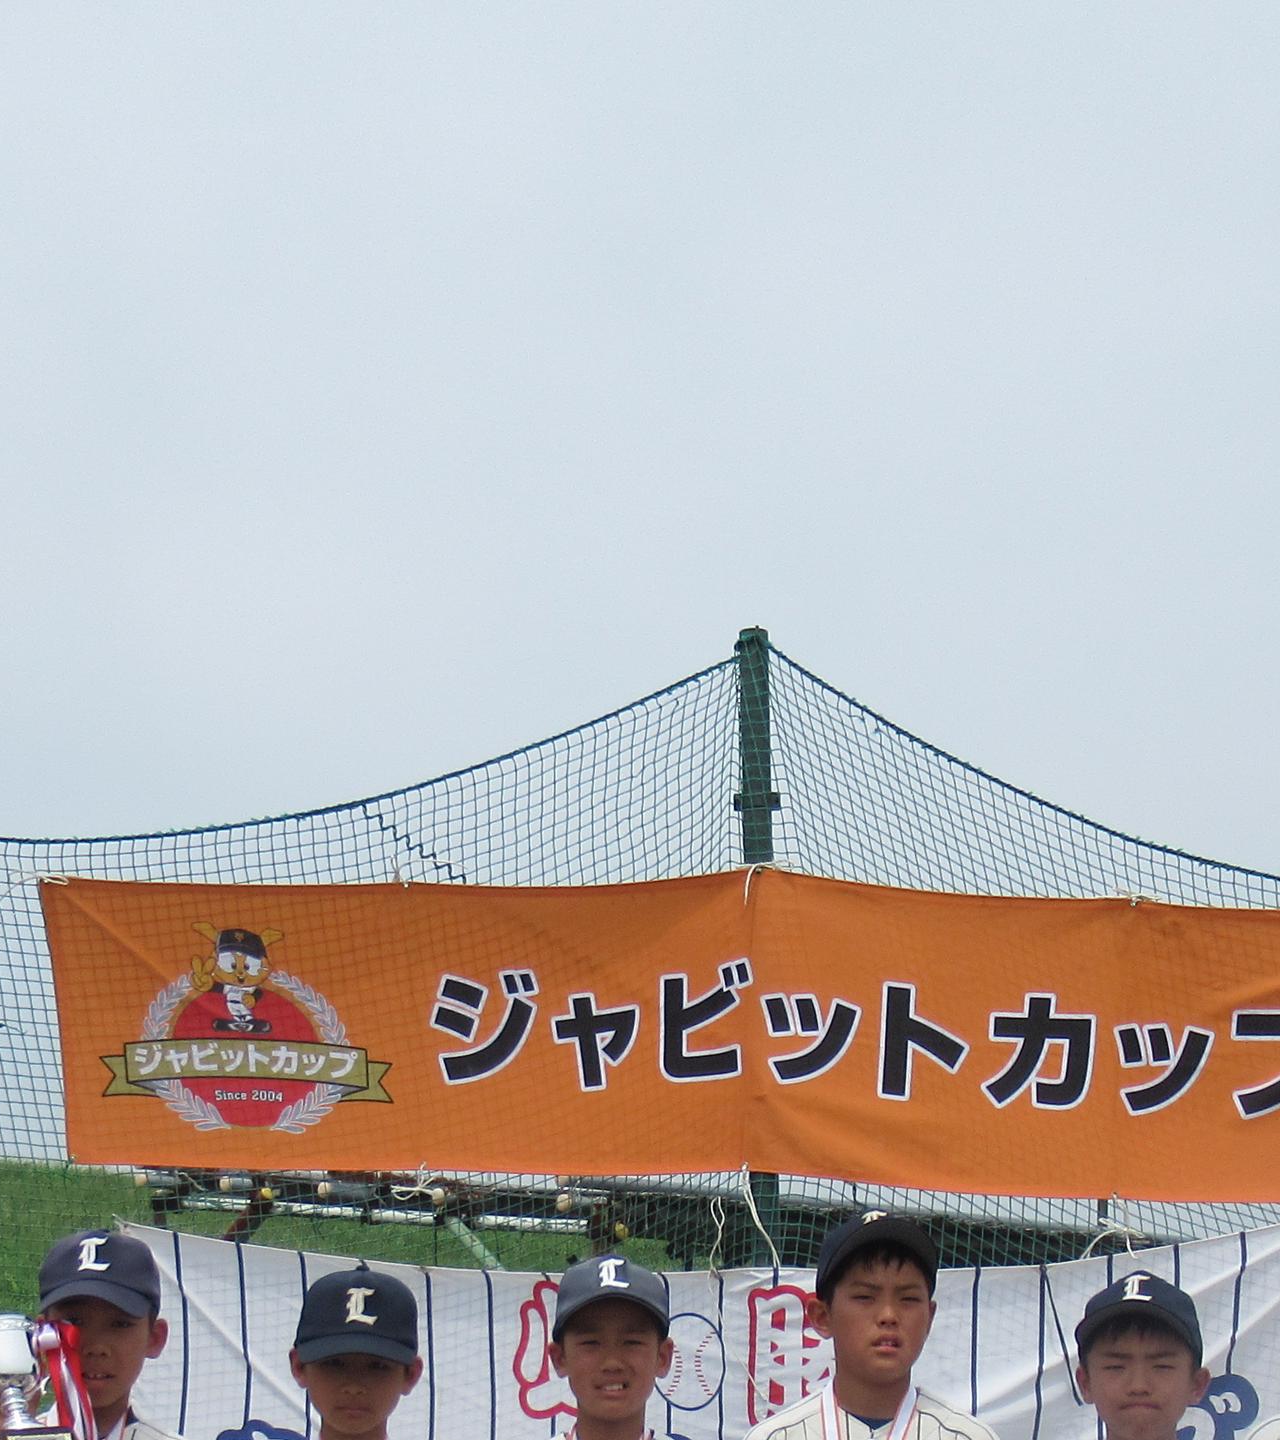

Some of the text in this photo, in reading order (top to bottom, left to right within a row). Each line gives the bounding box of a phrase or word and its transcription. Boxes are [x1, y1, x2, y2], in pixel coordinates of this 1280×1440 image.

[134, 1042, 359, 1079] ジャビットカップ
[215, 1089, 283, 1103] Since 2004
